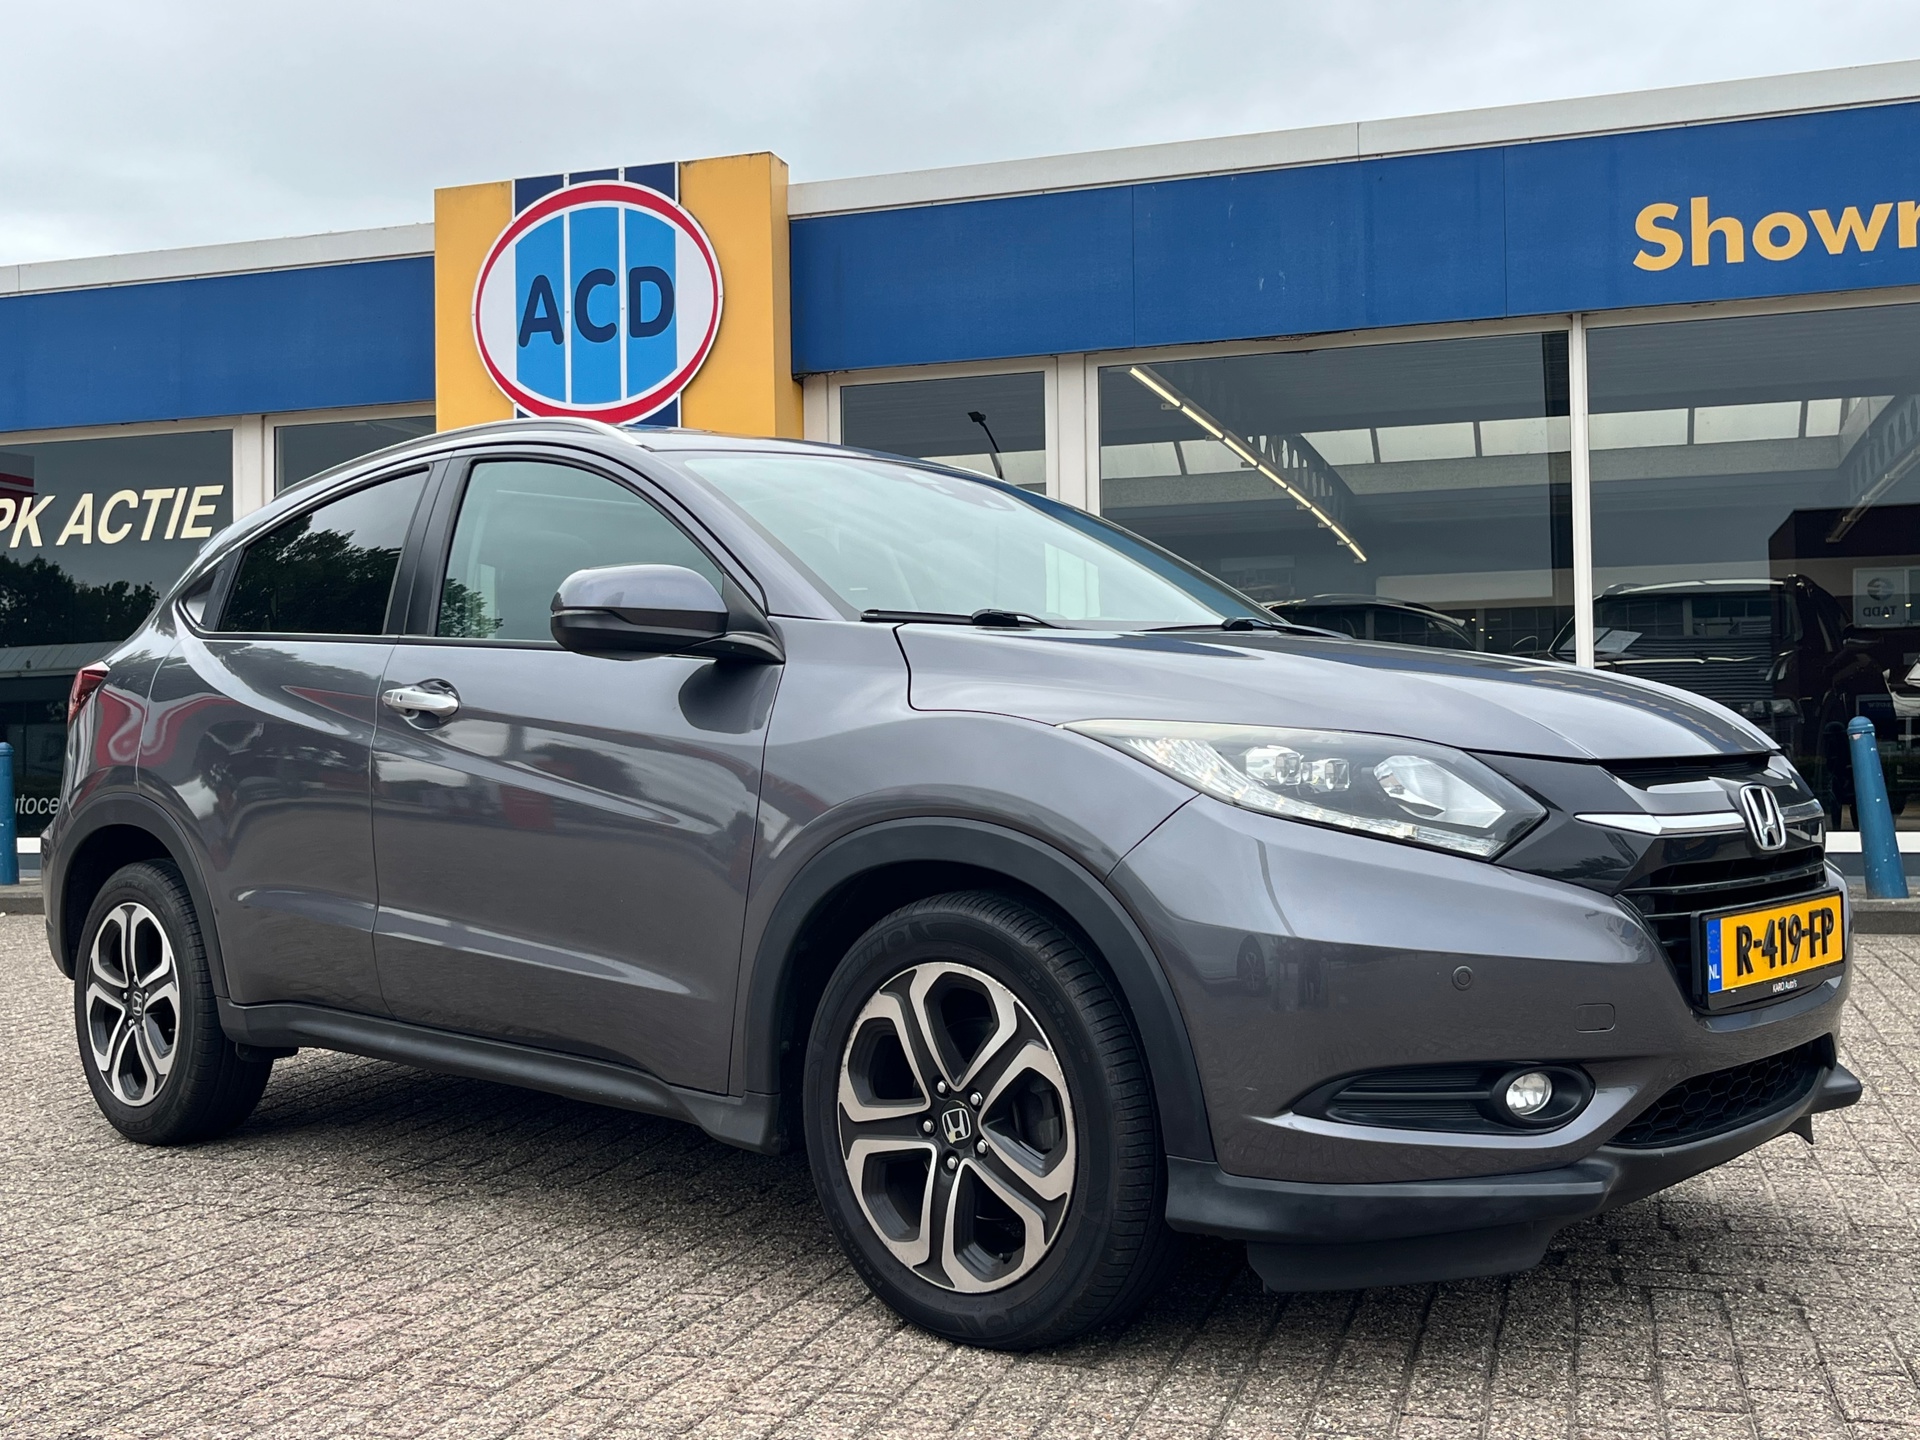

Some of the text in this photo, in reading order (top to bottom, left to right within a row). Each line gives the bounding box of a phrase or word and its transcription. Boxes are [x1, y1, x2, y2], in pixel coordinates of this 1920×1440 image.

[518, 266, 675, 348] ACD
[56, 485, 224, 546] ACTIE
[1708, 963, 1720, 980] NL
[1736, 907, 1834, 977] R-419-FP
